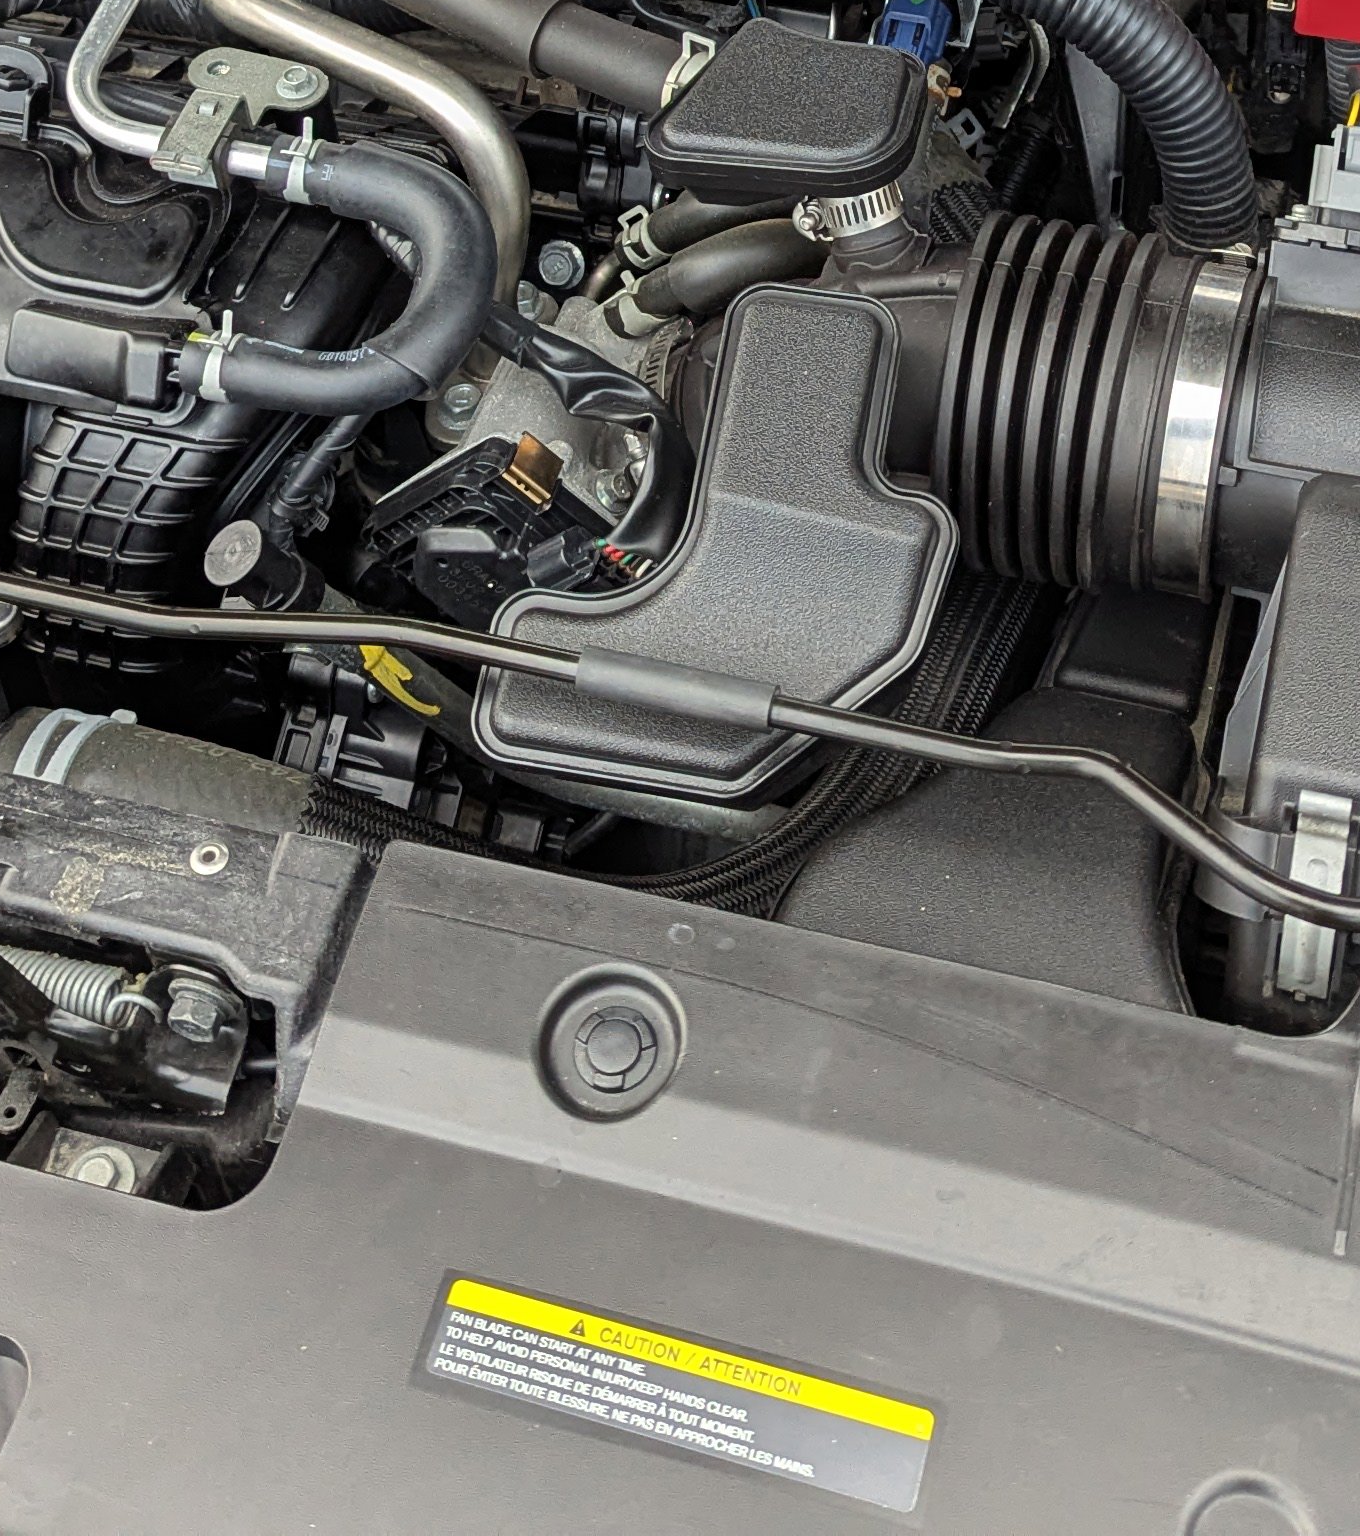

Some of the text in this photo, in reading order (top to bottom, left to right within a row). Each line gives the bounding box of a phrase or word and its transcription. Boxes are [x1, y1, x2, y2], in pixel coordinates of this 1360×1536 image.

[438, 1341, 757, 1444] LE VENTILATEUR RISQUE DE DÉMARRER À TOUT MOMENT.
[444, 1325, 463, 1341] TO
[461, 1330, 494, 1350] HELP
[492, 1339, 531, 1360] AVOID
[529, 1349, 592, 1378] PERSONAL
[662, 1388, 708, 1411] HANDS
[704, 1400, 751, 1424] CLEAR.
[449, 1310, 649, 1378] FAN BLADE CAN START AT ANY TIME.
[597, 1324, 682, 1364] CAUTION
[697, 1352, 804, 1398] ATTENTION
[432, 1356, 817, 1479] POUR ÉVITER TOUTE BLESSURE, NE PAS EN APPROCHER LES MAINS.
